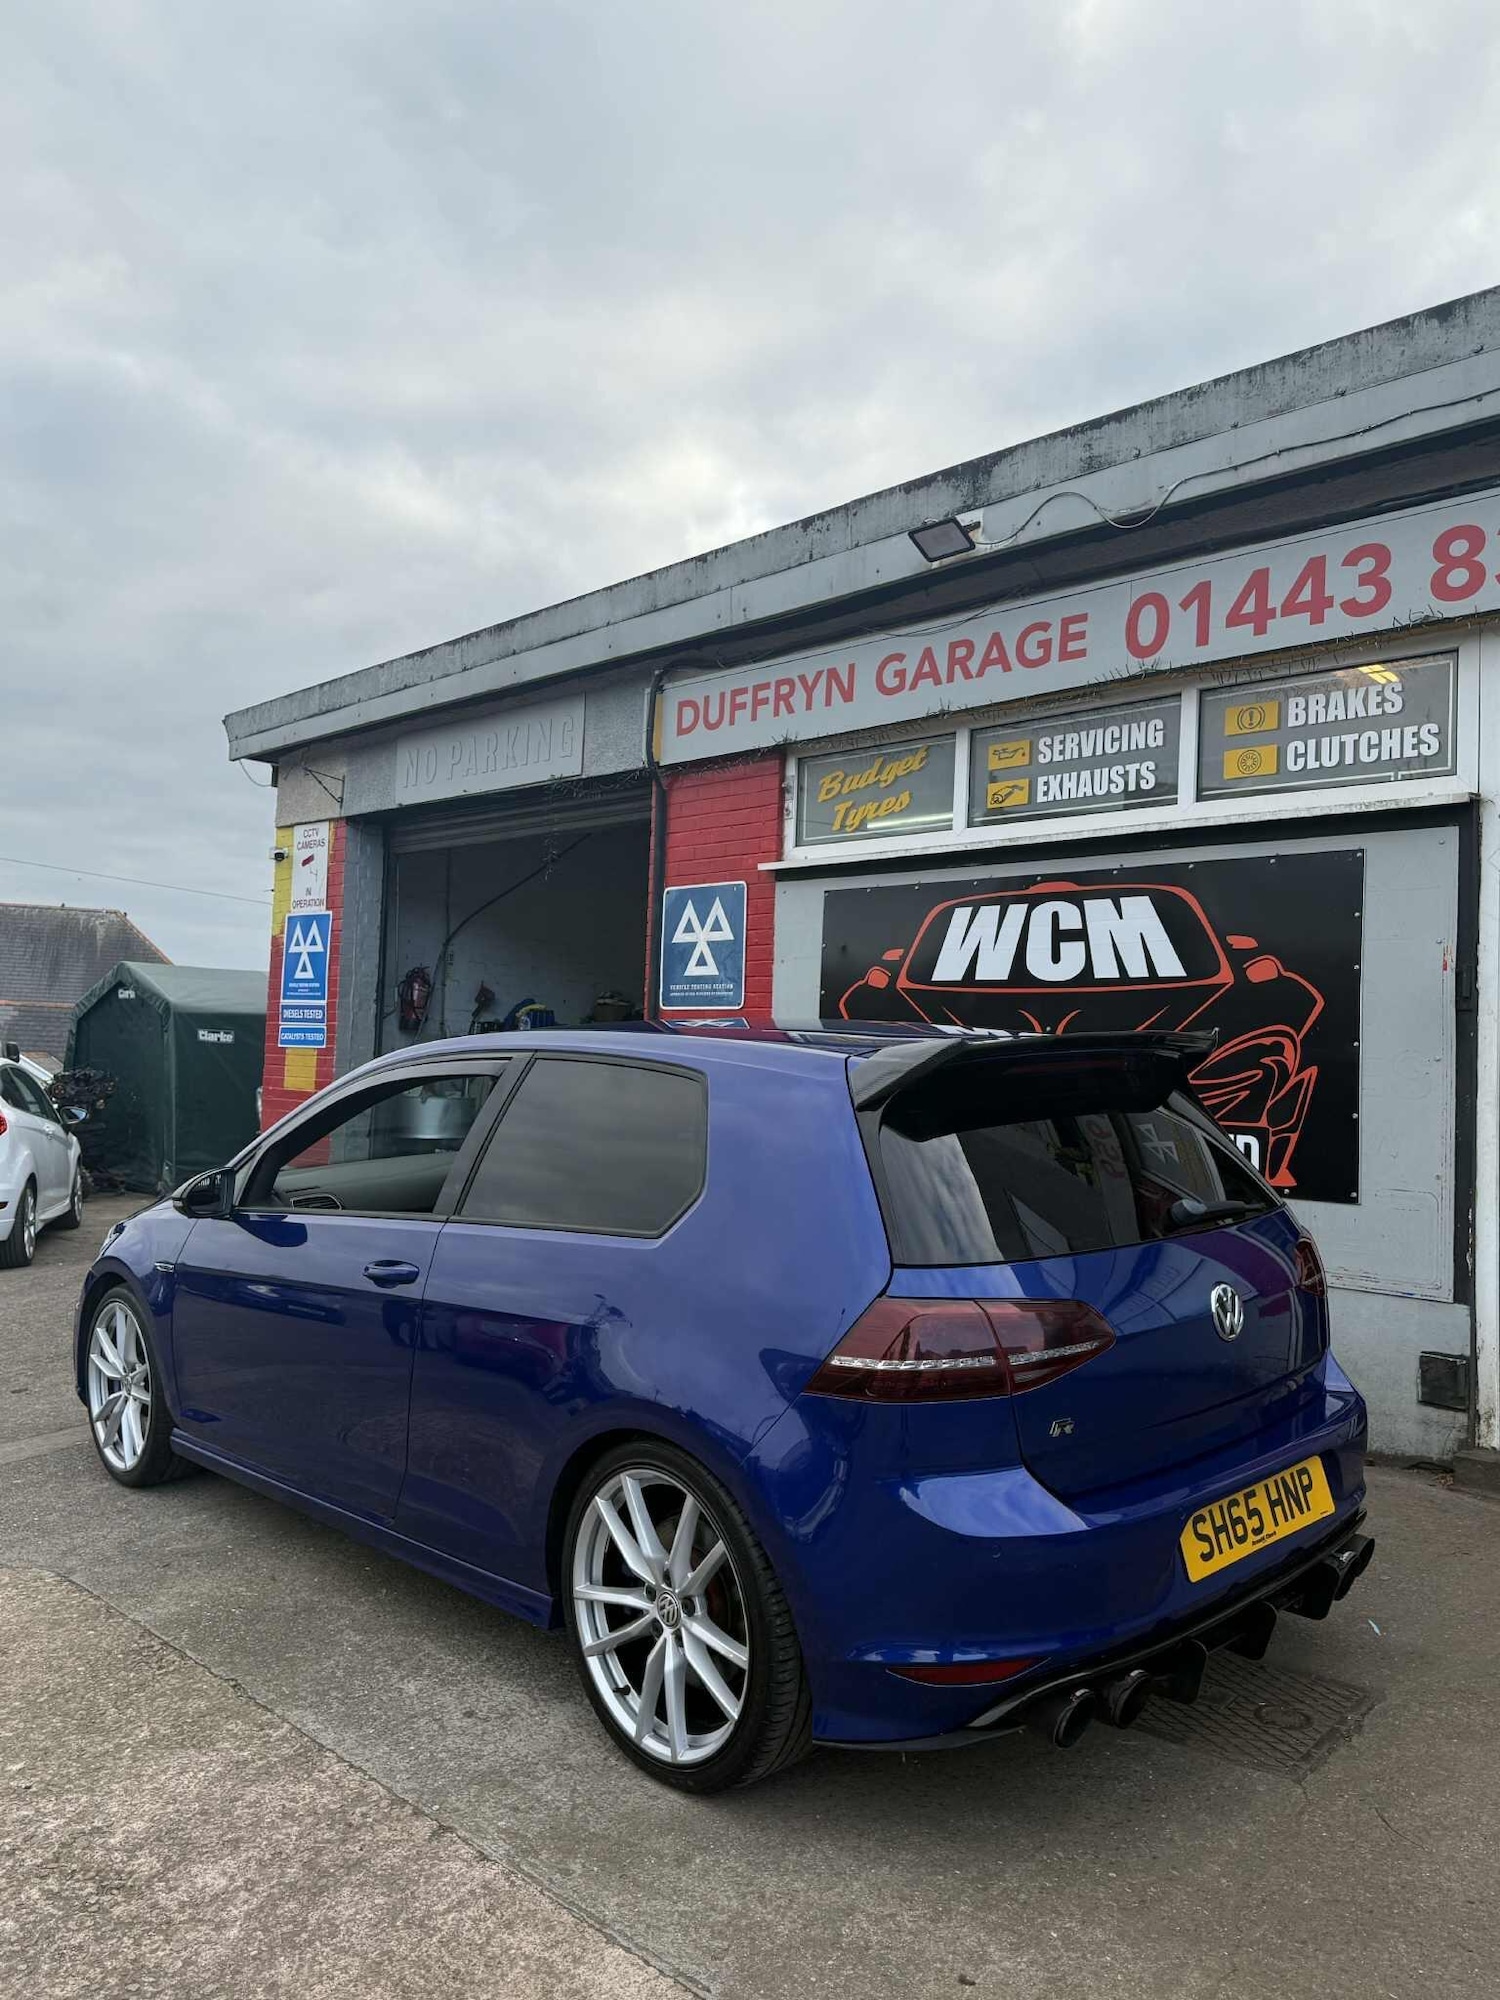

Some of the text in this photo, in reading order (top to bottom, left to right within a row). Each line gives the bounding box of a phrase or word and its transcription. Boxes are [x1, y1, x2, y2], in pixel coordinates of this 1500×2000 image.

[676, 524, 1500, 737] DUFFRYN GARAGE 01443 8
[1287, 682, 1403, 728] BRAKES
[403, 716, 575, 789] NO PARKING
[1037, 718, 1165, 765] SERVICING
[1286, 723, 1440, 772] CLUTCHES
[817, 744, 929, 802] Budget
[1036, 761, 1157, 804] EXHAUSTS
[303, 827, 320, 838] CCTV
[830, 789, 912, 833] Tyres
[296, 838, 326, 851] CAMERAS
[291, 898, 325, 910] OPERATION
[305, 887, 312, 896] IN
[930, 895, 1188, 983] WCM
[283, 1008, 323, 1019] DIESELS TESTED
[198, 1029, 233, 1043] Clarke
[305, 1032, 324, 1041] TESTED
[1192, 1466, 1313, 1562] SH65 HNP
